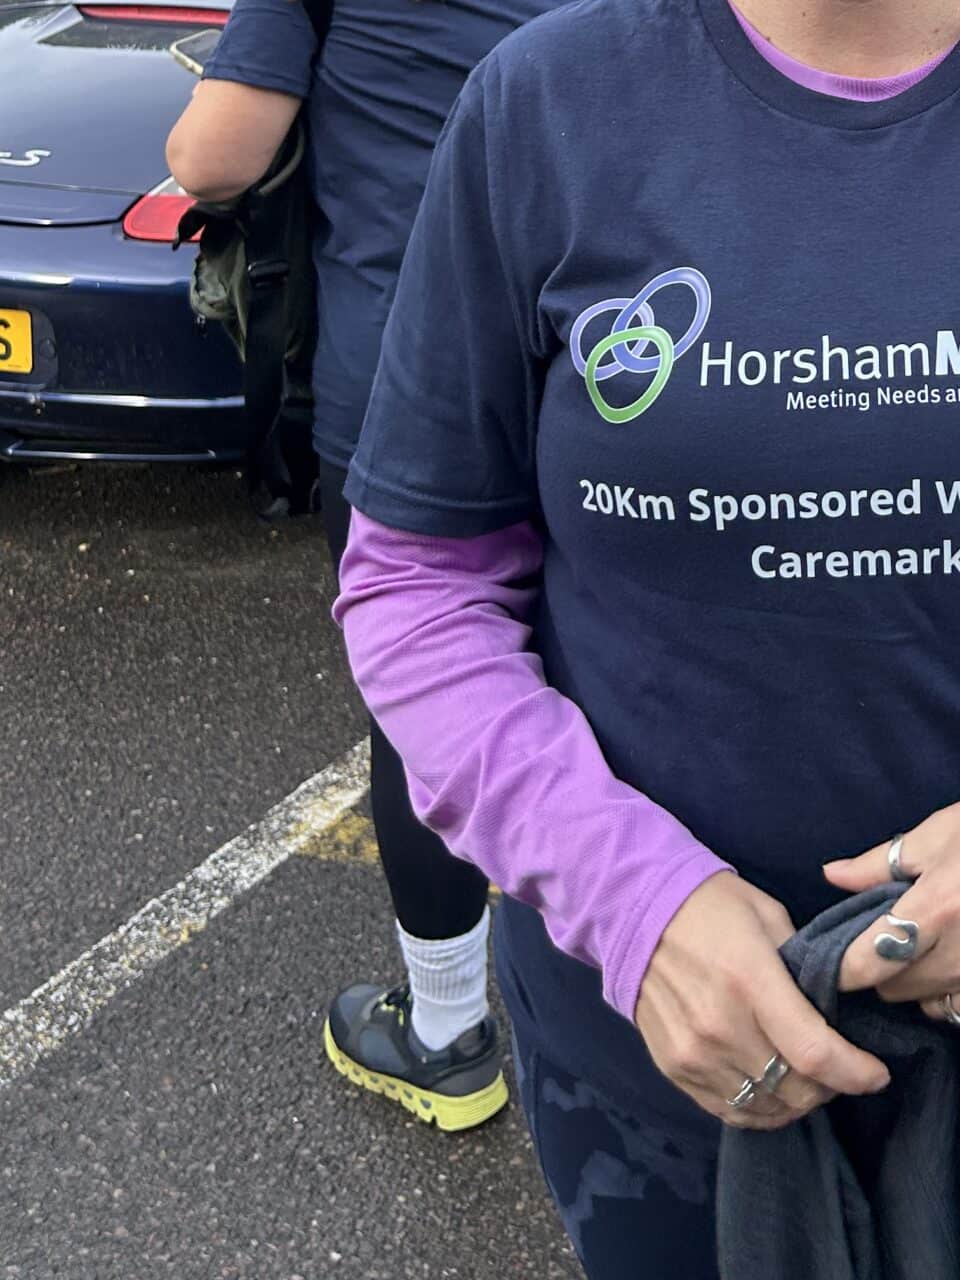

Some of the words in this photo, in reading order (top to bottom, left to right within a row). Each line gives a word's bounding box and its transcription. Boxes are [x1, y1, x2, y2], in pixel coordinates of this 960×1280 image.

[786, 390, 871, 412] Meeting
[877, 386, 941, 406] Needs
[579, 478, 676, 521] 20Km
[689, 478, 922, 531] Sponsored
